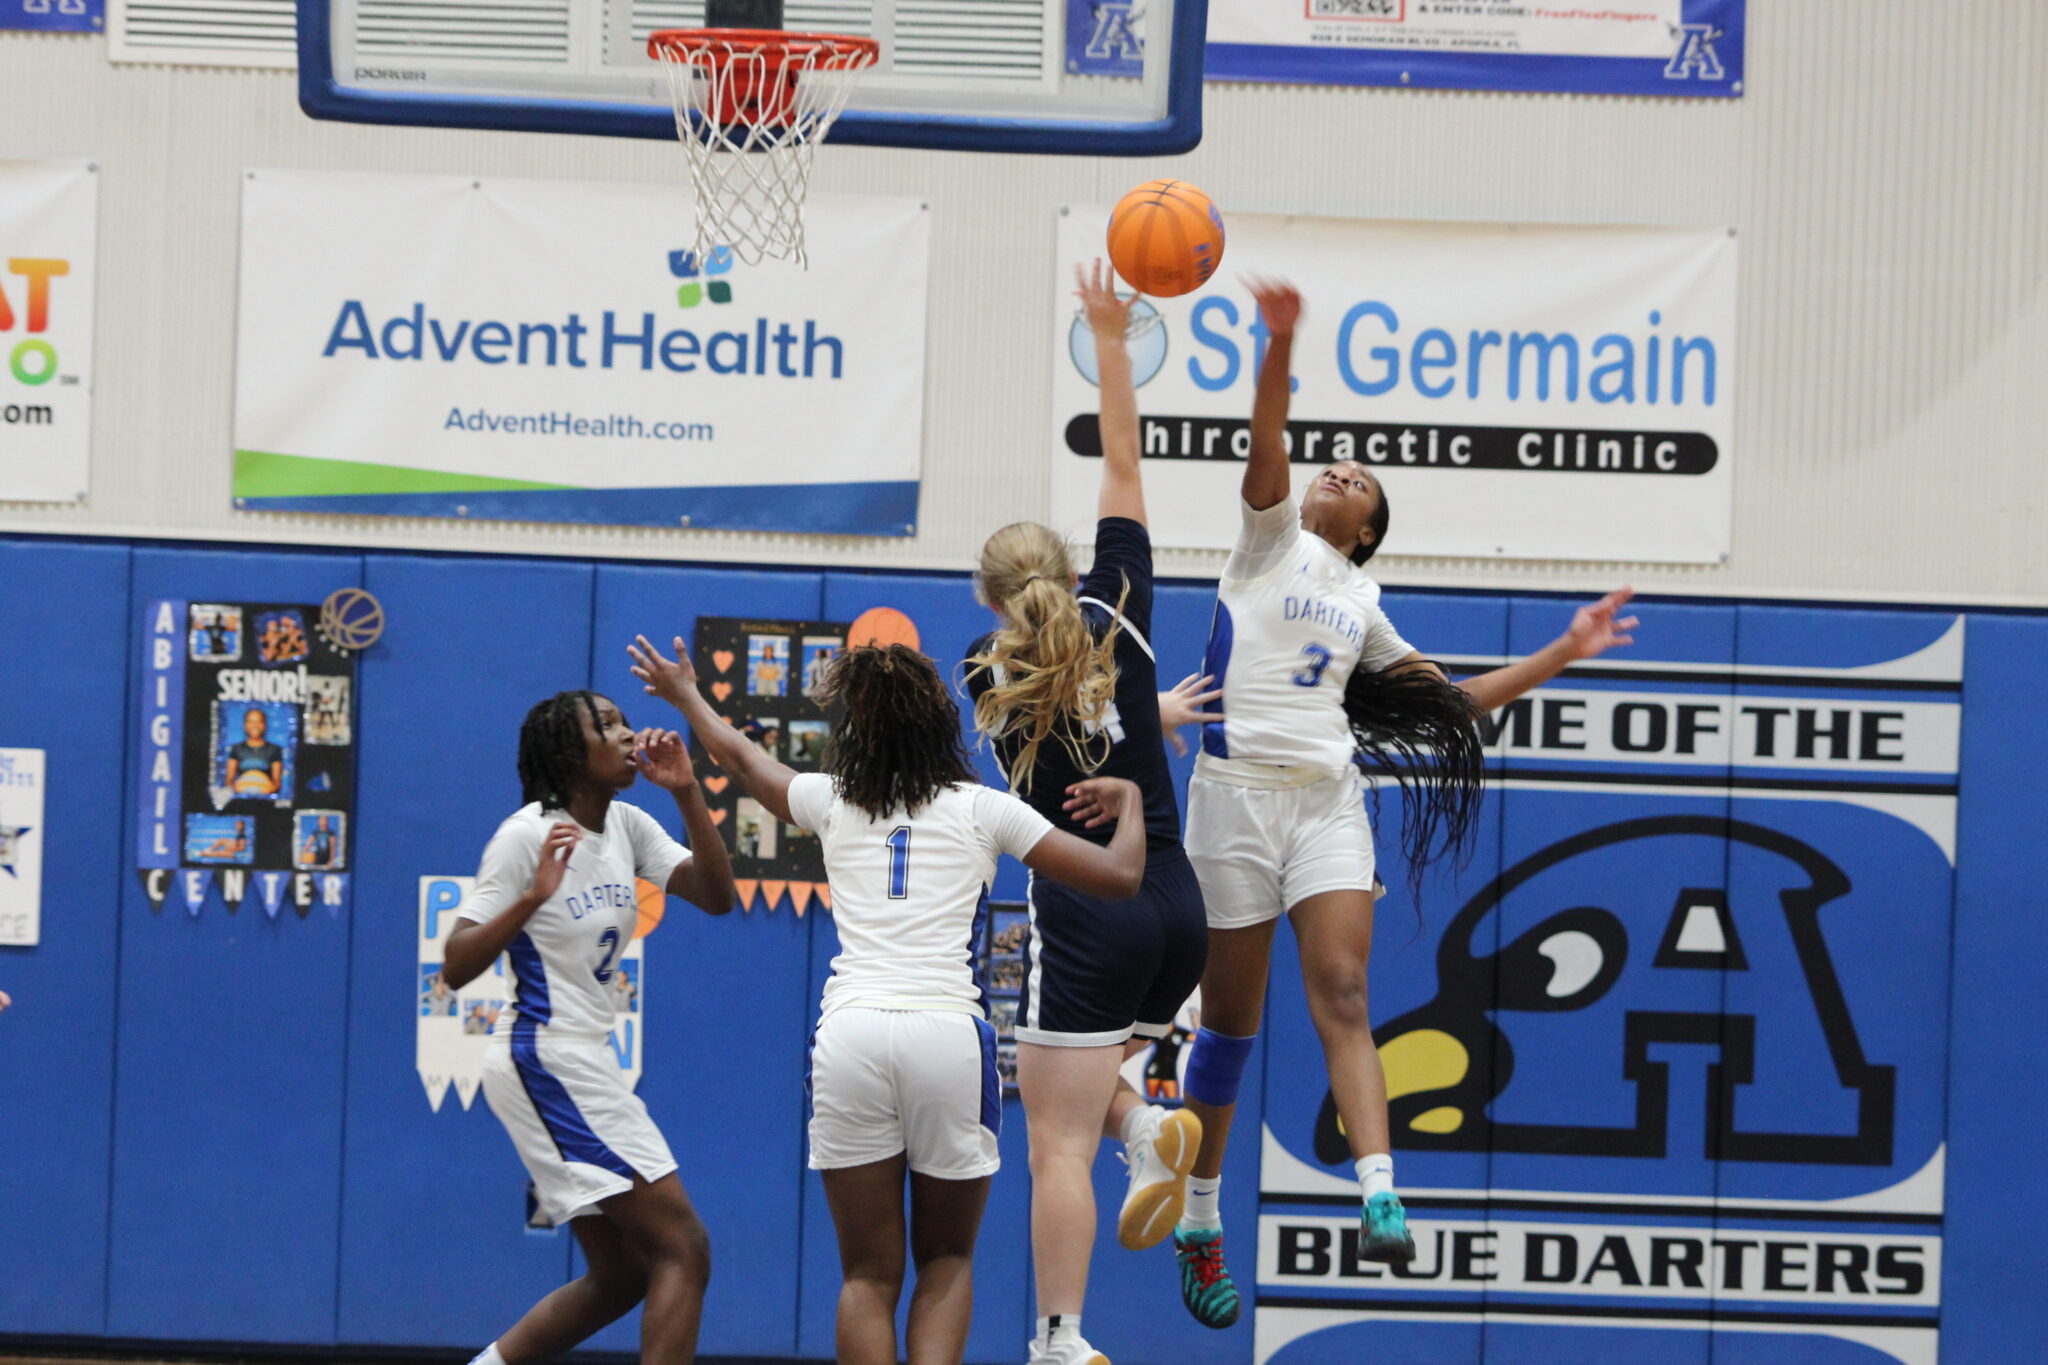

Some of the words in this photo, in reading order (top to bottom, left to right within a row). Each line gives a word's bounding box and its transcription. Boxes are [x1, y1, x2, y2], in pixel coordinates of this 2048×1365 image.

[1433, 5, 1483, 15] ENTER
[1336, 300, 1717, 407] Germain
[444, 407, 714, 442] AdventHealth.com
[1517, 432, 1678, 471] Clinic
[217, 664, 308, 704] SENIOR!
[1292, 642, 1333, 688] 3
[151, 602, 176, 855] ABIGAIL
[1612, 701, 1721, 754] OF
[1741, 706, 1906, 763] THE
[147, 869, 342, 906] CENTER
[885, 825, 912, 900] 1
[593, 925, 620, 985] 2
[1276, 1224, 1498, 1281] BLUE
[1522, 1231, 1925, 1297] DARTERS
